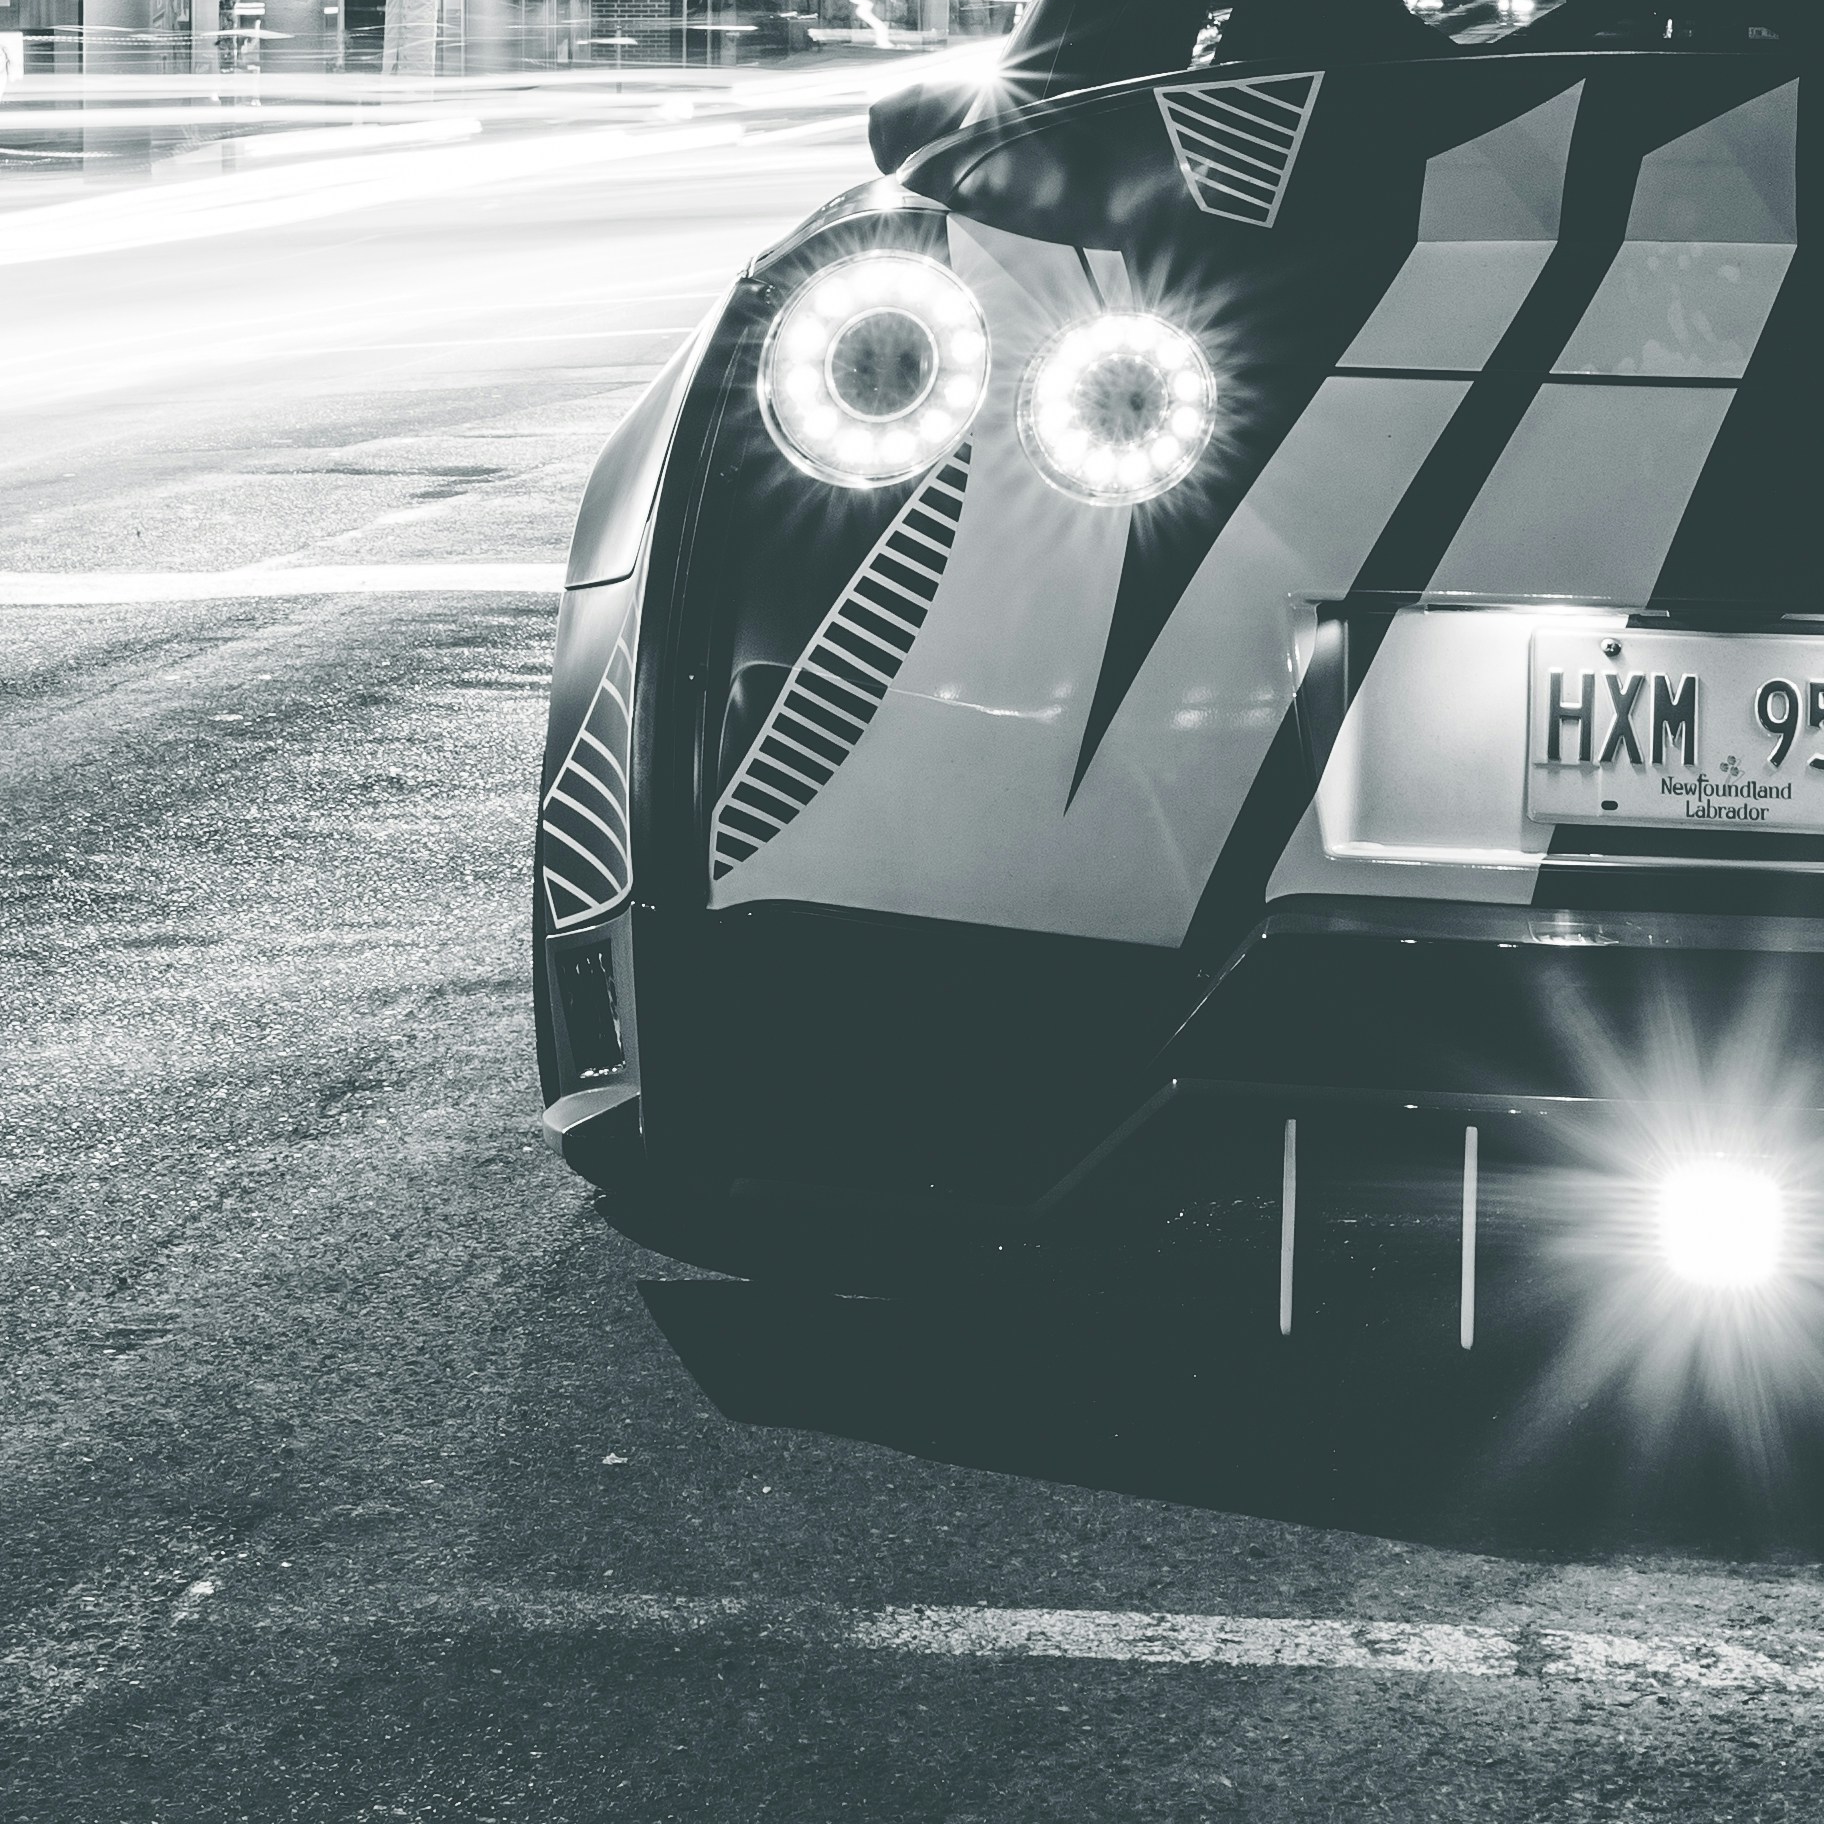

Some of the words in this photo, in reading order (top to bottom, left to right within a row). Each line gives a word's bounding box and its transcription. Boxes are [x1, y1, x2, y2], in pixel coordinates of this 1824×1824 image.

[1547, 672, 1698, 766] HXM
[1660, 773, 1792, 802] Newfoundland
[1686, 800, 1769, 821] Labrador
